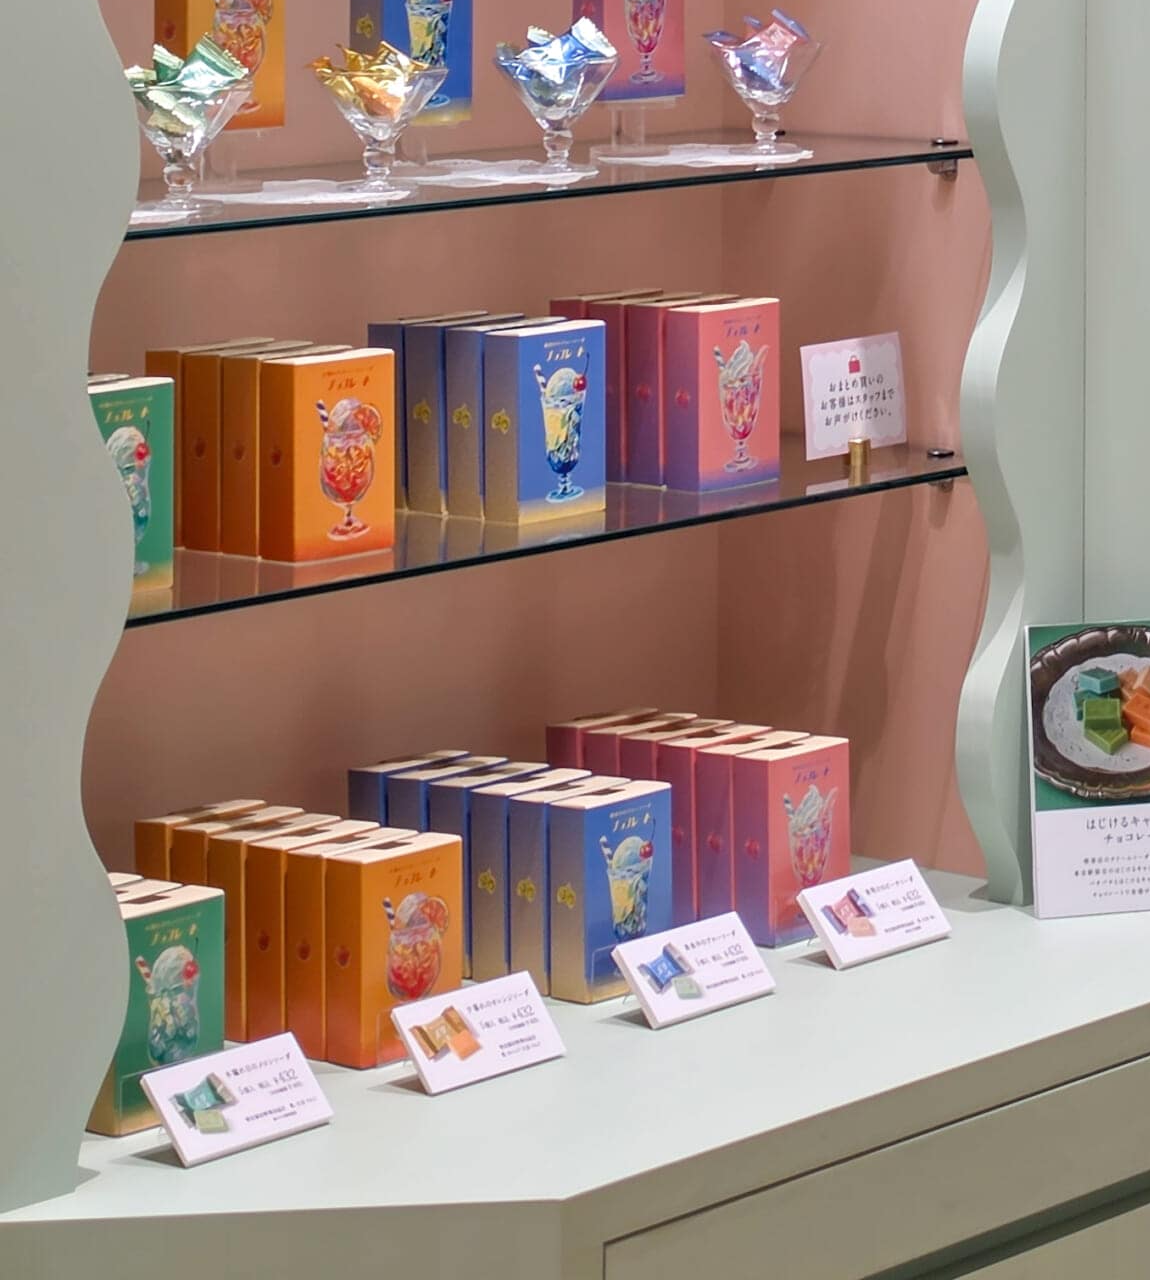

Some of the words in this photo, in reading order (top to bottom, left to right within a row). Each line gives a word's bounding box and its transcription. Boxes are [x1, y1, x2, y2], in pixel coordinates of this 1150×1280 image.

[829, 373, 884, 393] おまとめ買いの
[821, 387, 895, 411] お客様はスタッフまで
